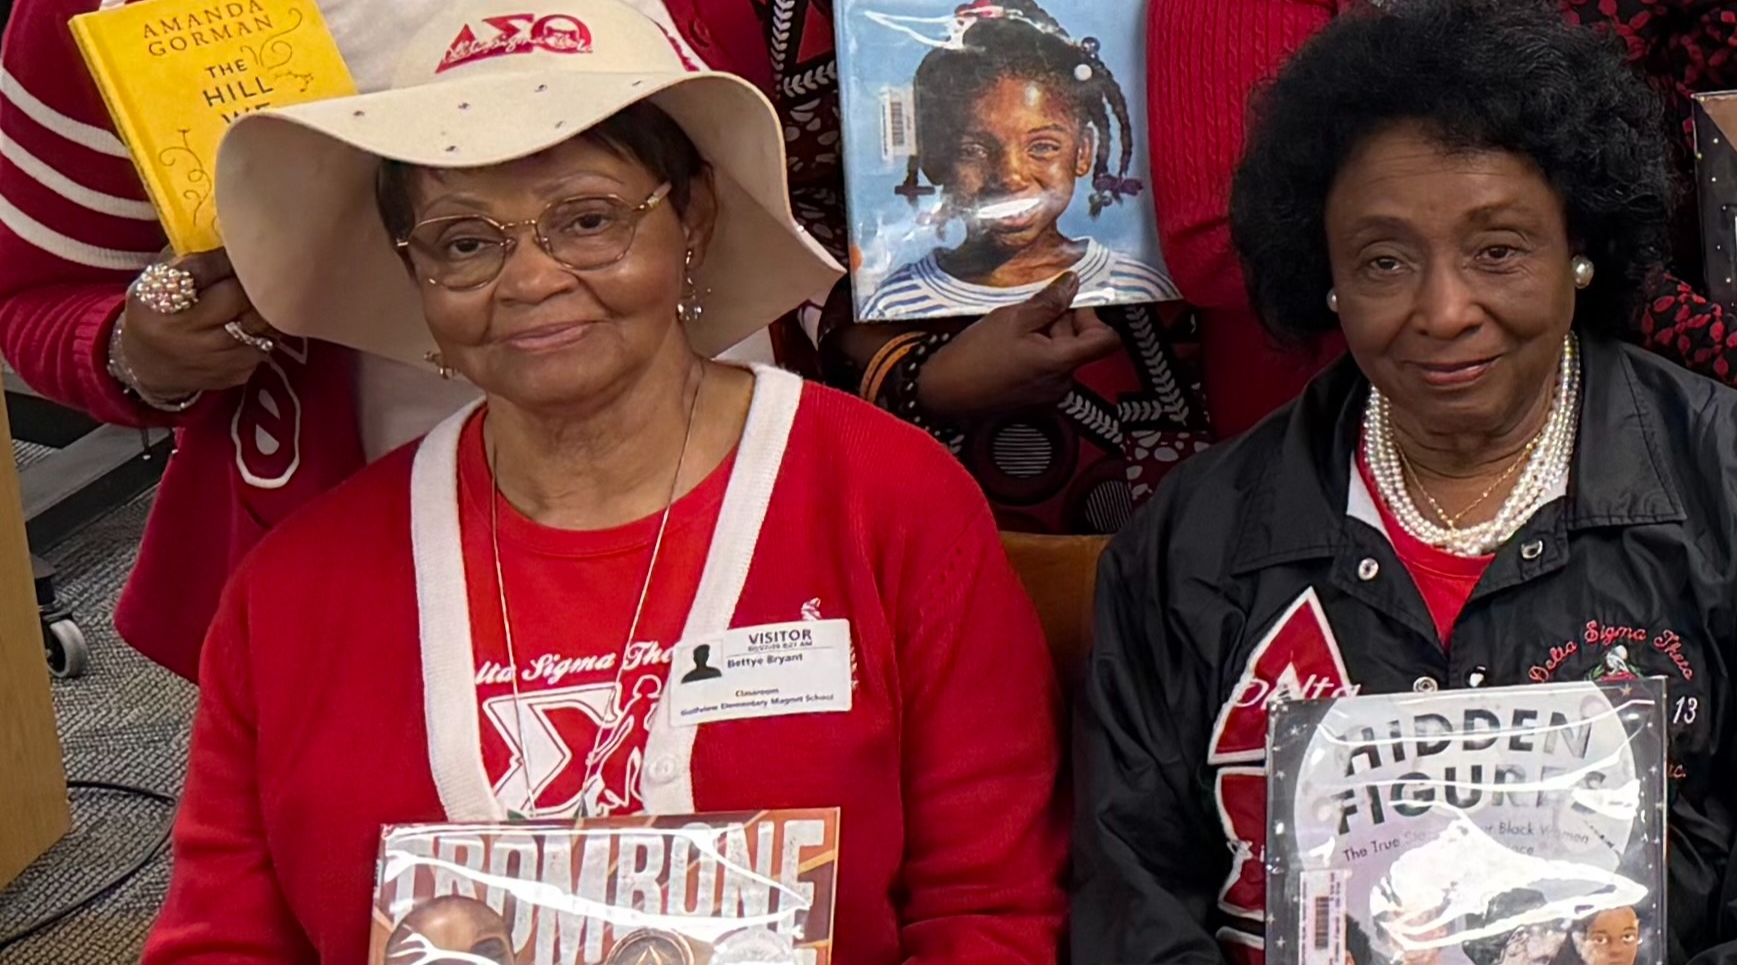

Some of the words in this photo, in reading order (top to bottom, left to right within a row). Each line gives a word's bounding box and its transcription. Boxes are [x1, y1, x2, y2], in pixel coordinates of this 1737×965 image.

[147, 14, 276, 58] GORMAN
[204, 57, 249, 80] THE
[202, 76, 275, 108] HILL
[748, 629, 812, 645] VISITOR
[1528, 640, 1578, 683] Delta
[1584, 619, 1648, 646] Sigma
[1653, 629, 1694, 681] Theta
[521, 652, 617, 685] Sigma
[727, 655, 764, 668] Bettye
[766, 652, 803, 665] Bryant
[720, 698, 769, 711] Elementary
[770, 695, 804, 706] Magnet
[805, 692, 835, 702] School
[1672, 695, 1698, 724] 13
[1343, 708, 1593, 776] HIDDEN
[1342, 845, 1368, 862] The
[1370, 839, 1401, 856] True
[1498, 821, 1535, 836] Black
[383, 820, 826, 965] TROMBONE
